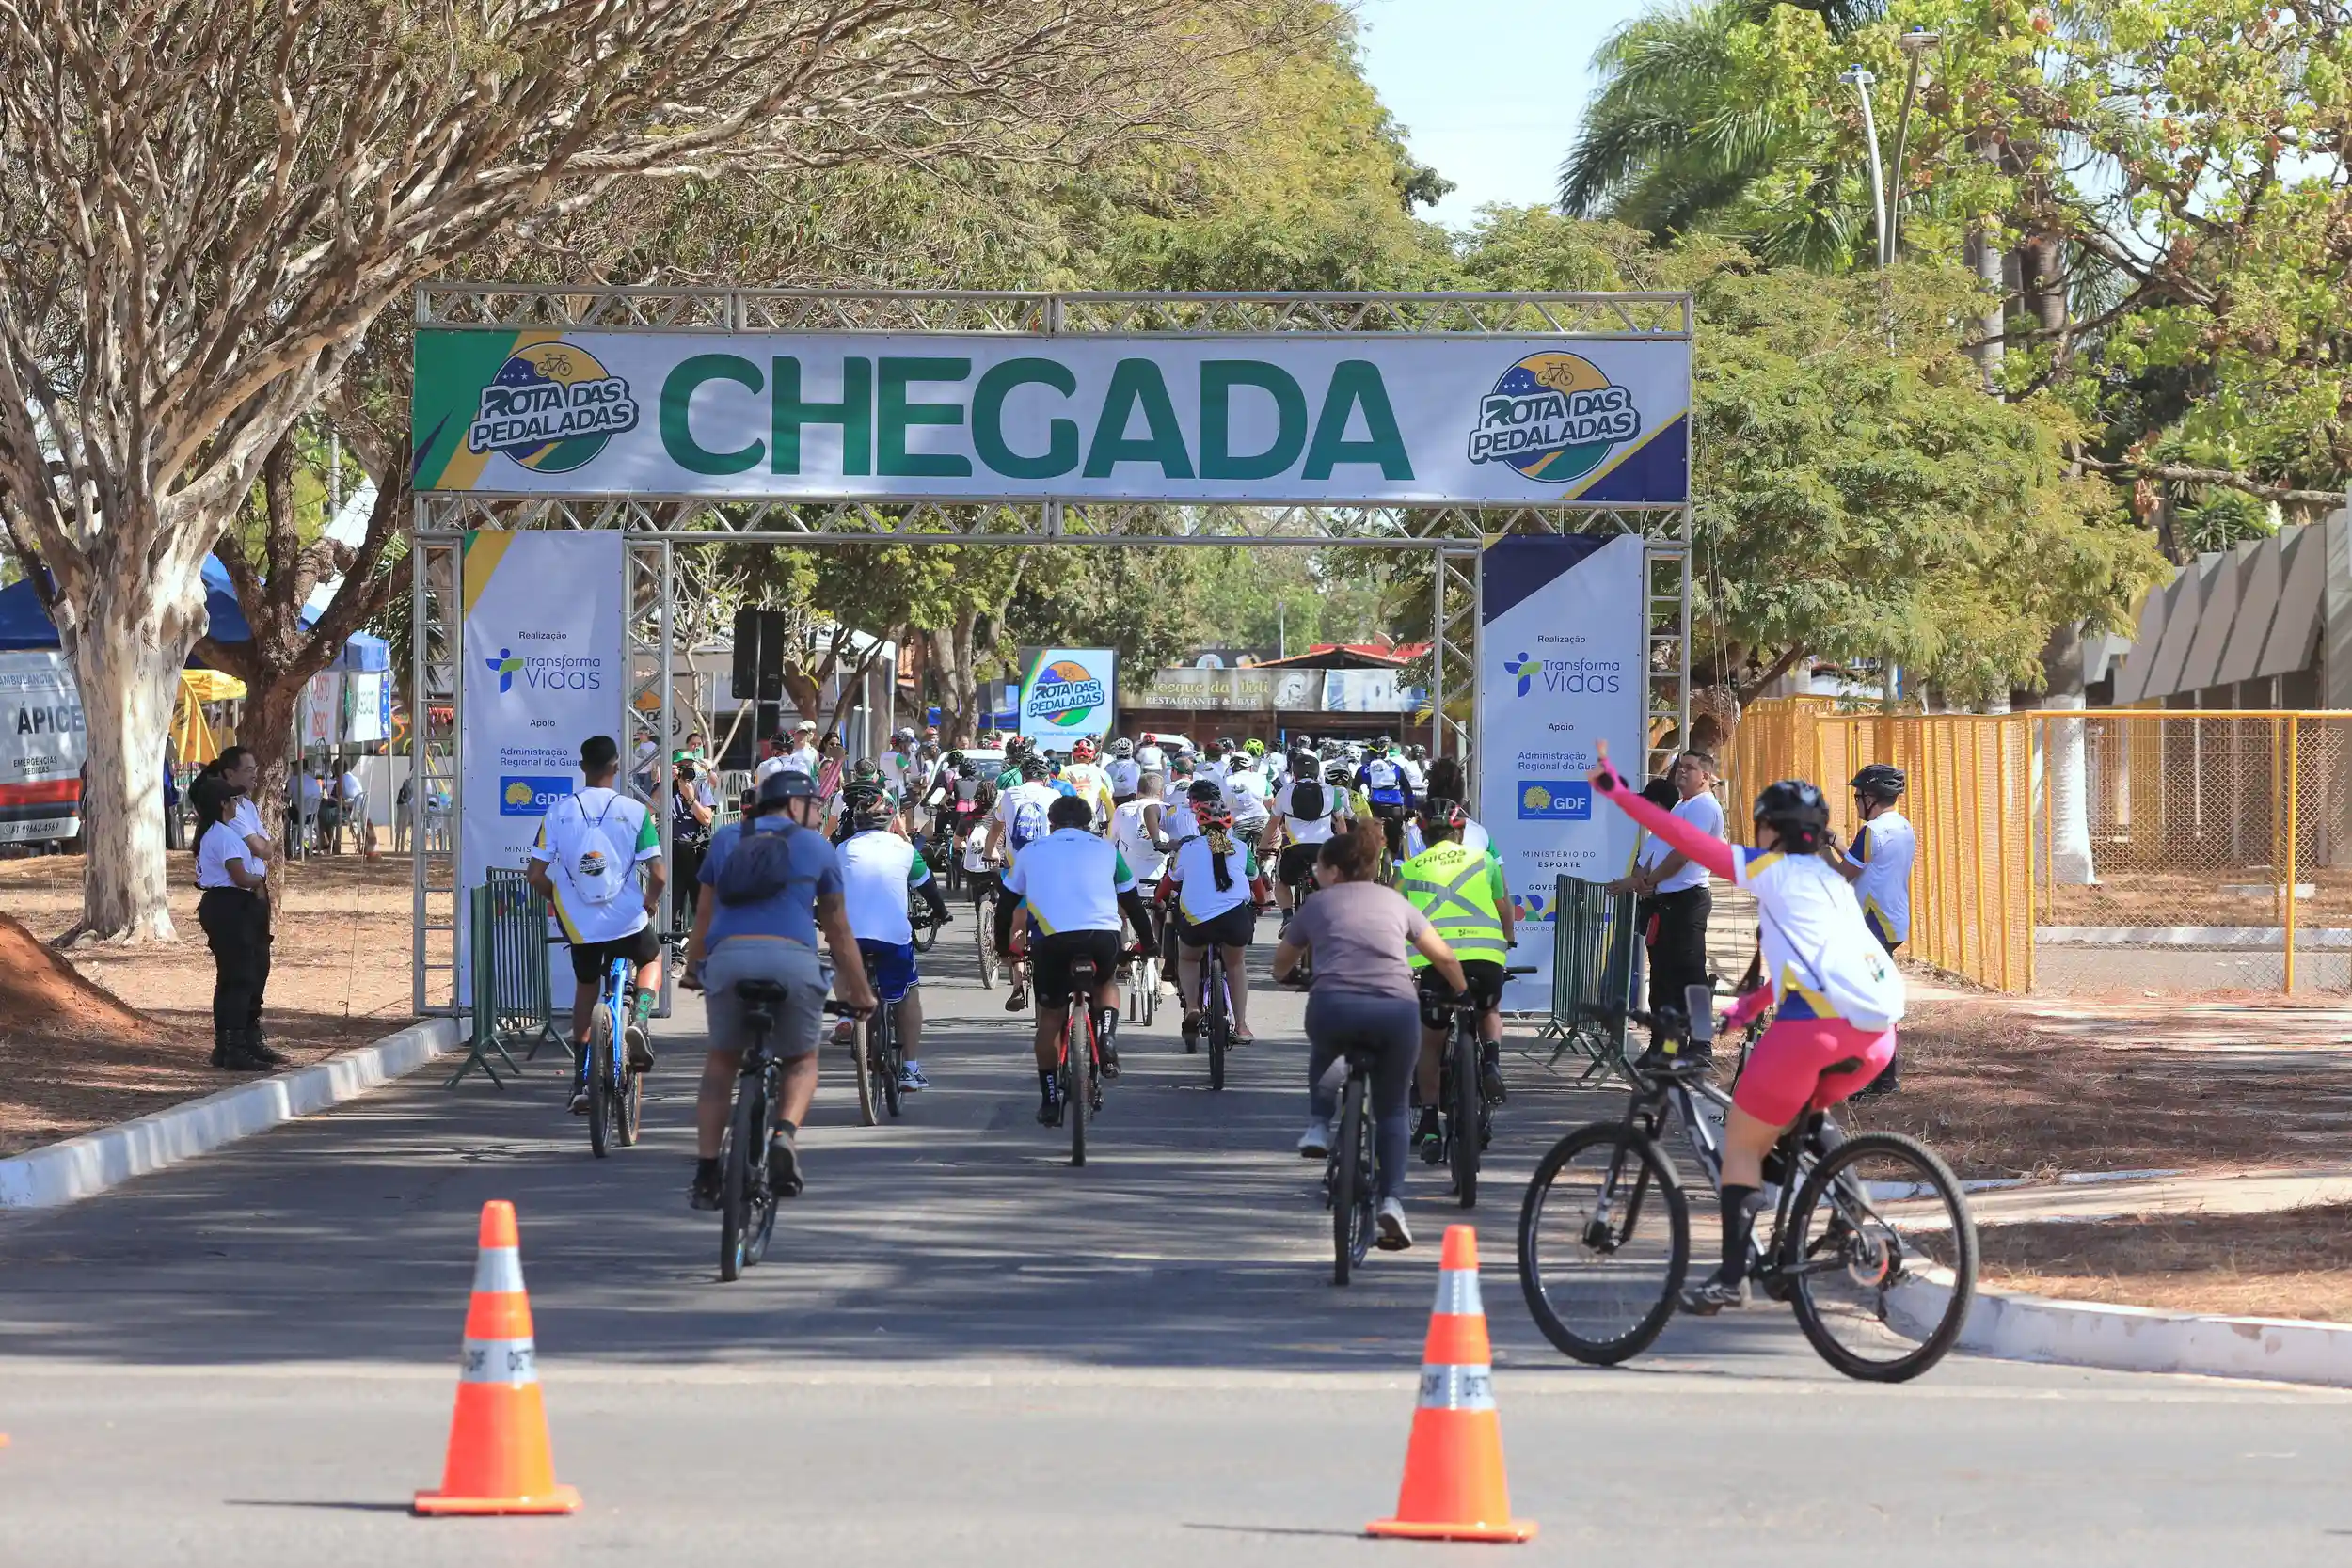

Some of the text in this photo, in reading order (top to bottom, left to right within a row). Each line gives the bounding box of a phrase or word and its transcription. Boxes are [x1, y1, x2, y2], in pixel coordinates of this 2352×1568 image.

[484, 382, 621, 419] ROTA DAS
[1485, 391, 1622, 428] ROTA DAS
[473, 404, 629, 446] PEDALADAS
[659, 354, 1416, 482] CHEGADA
[1474, 412, 1631, 455] PEDALADAS
[518, 631, 567, 641] Realização
[1537, 635, 1586, 644] Realização
[524, 654, 601, 670] Transforma
[1543, 657, 1620, 673] Transforma
[524, 667, 600, 689] Vidas
[1543, 671, 1620, 693] Vidas
[1035, 682, 1097, 700] ROTA DAS
[1030, 691, 1102, 713] PEDALADAS
[1145, 696, 1258, 705] RESTAURANTE & BAR
[17, 700, 86, 735] ÁPICE
[530, 719, 556, 728] Apoio
[1548, 722, 1574, 732] Apoio
[500, 747, 568, 757] Administração
[1518, 752, 1587, 761] Administração
[500, 757, 581, 768] Regional do Guar
[1518, 761, 1596, 771] Regional do Gua
[1553, 797, 1586, 810] GDF
[1414, 849, 1467, 868] CHICOS
